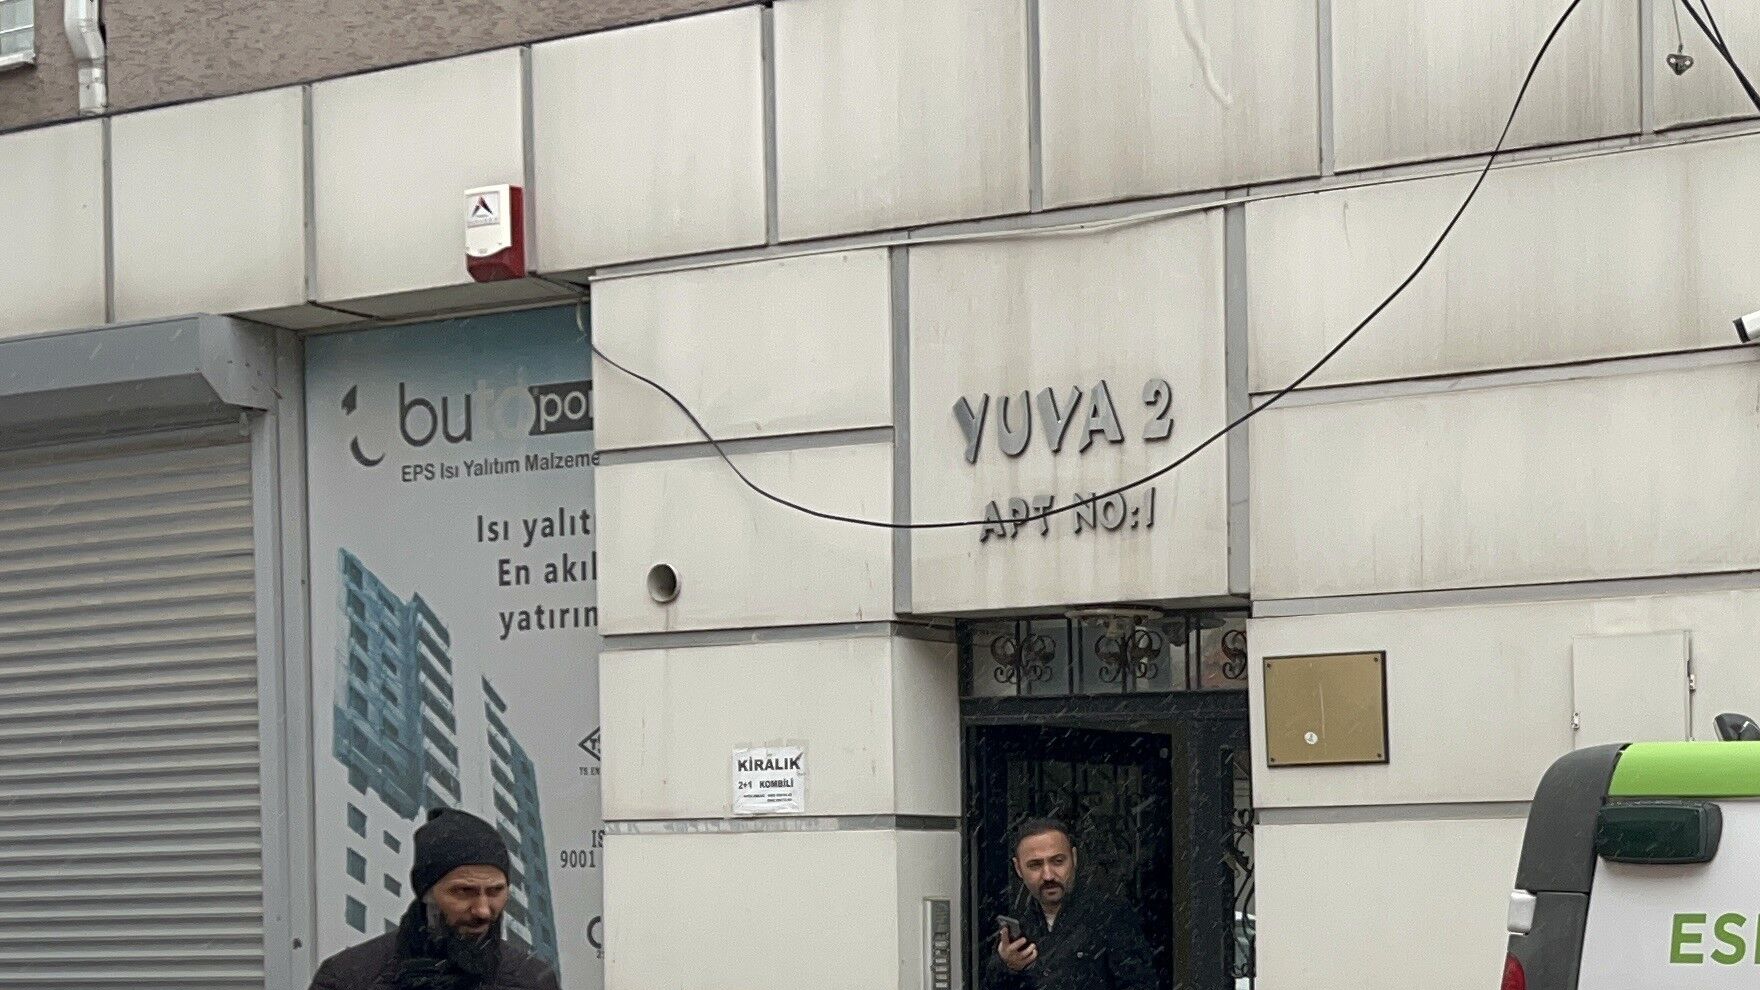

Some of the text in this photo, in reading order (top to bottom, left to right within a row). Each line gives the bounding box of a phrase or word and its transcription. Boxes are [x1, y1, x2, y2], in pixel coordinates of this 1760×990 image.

[952, 377, 1175, 466] YUVA 2
[401, 463, 435, 482] EPS
[979, 494, 1055, 544] APT
[499, 558, 530, 586] En
[560, 850, 596, 869] 9001
